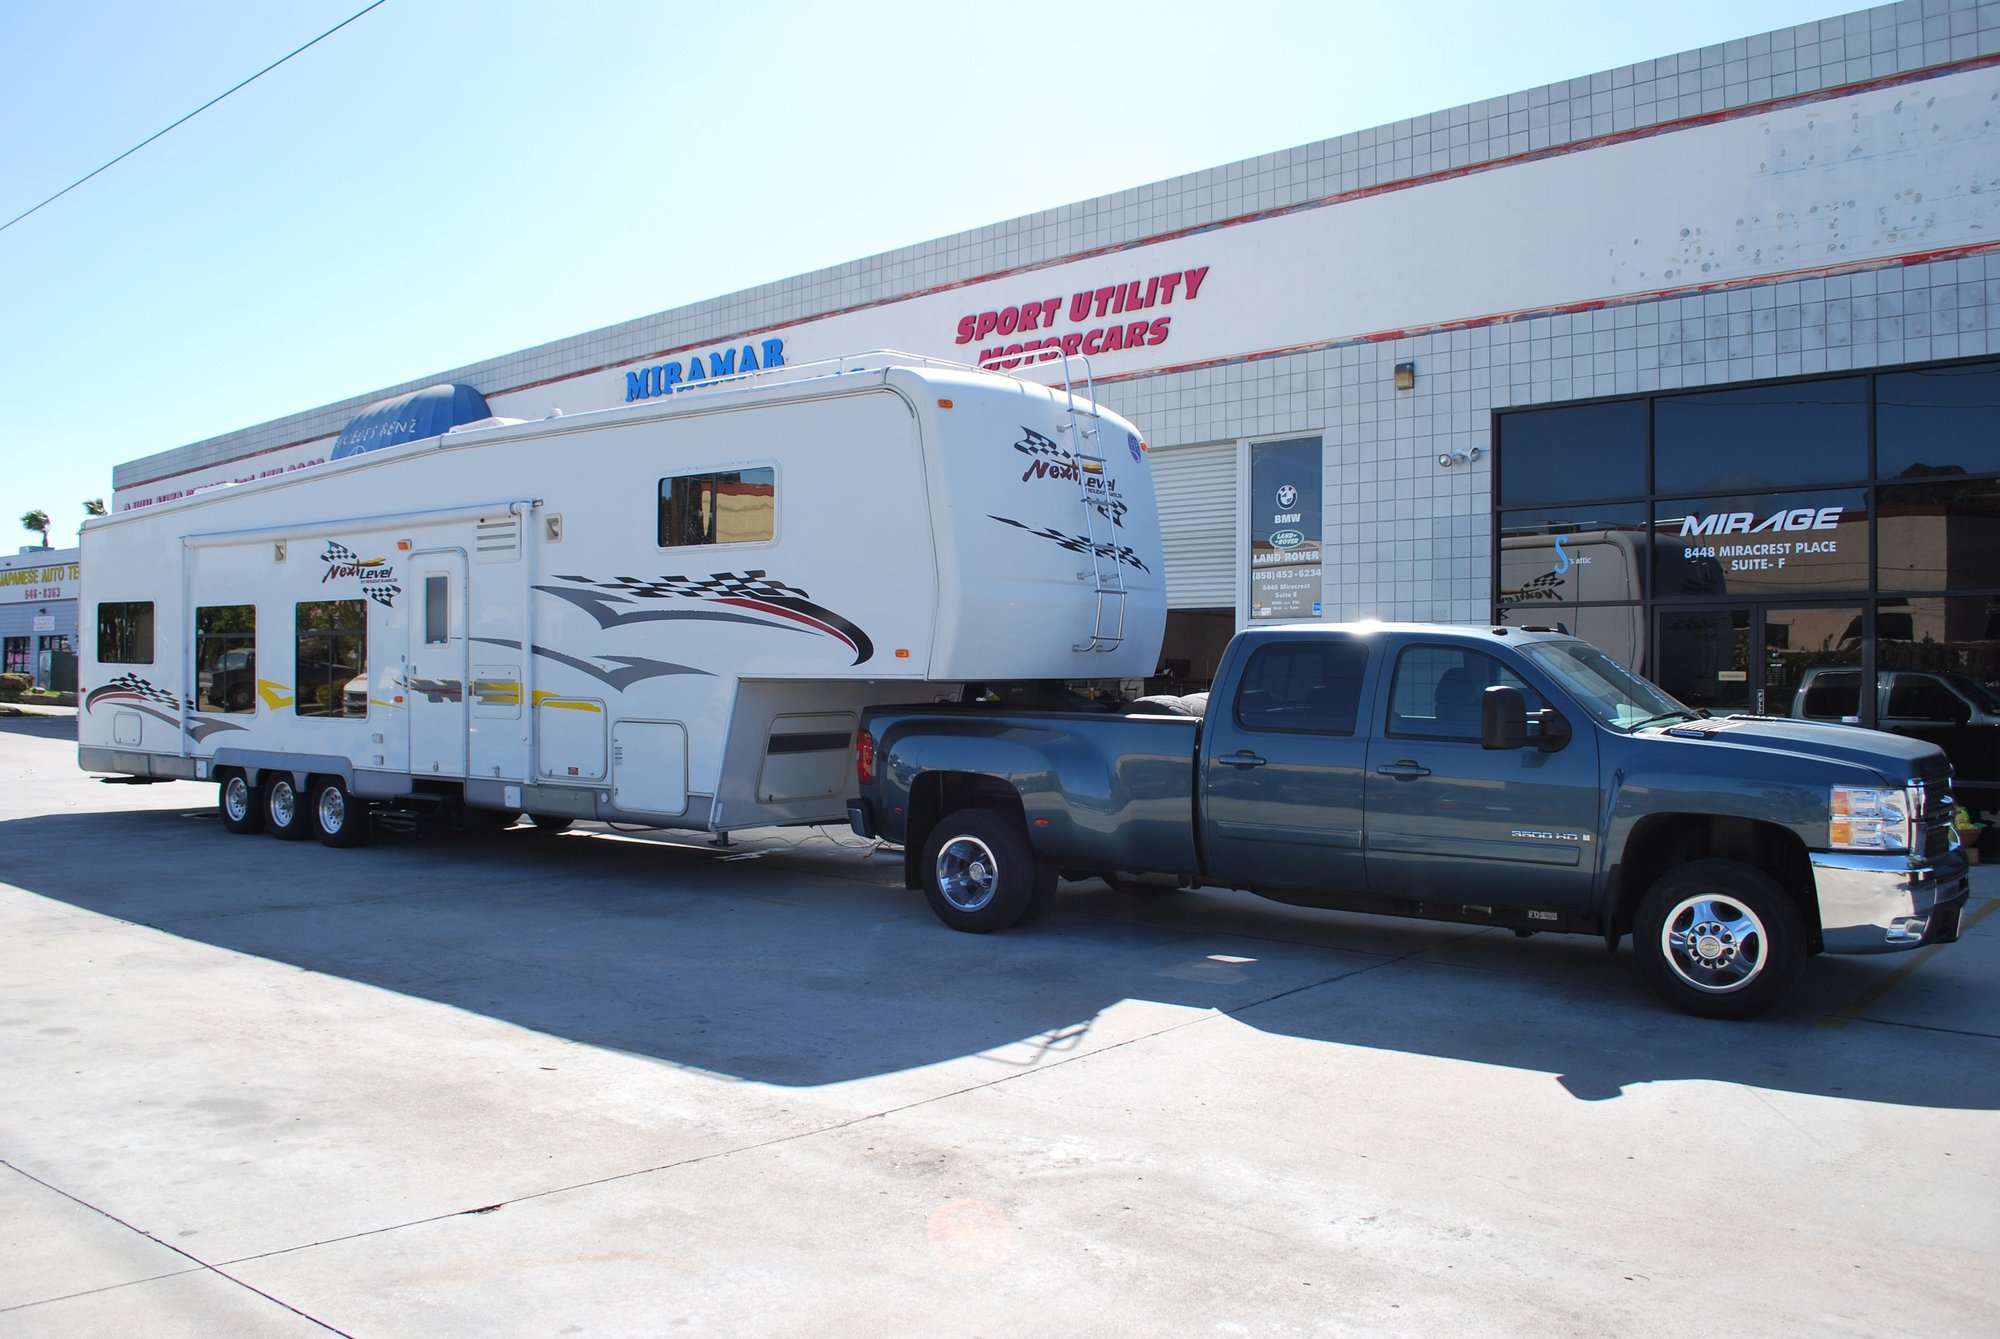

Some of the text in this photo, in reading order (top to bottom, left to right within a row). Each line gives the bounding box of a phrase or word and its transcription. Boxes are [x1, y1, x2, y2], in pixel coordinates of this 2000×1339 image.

[955, 265, 1210, 345] SPORT UTILITY
[977, 316, 1172, 371] MOTORCARS
[625, 338, 785, 402] MIRAMAR
[1021, 458, 1080, 483] Next
[1274, 513, 1302, 524] BMW
[1679, 506, 1844, 537] MIRAGE
[1253, 550, 1320, 563] LAND ROVER
[1684, 541, 1837, 559] 8448 MIRACREST PLACE
[1575, 556, 1592, 564] attic
[1778, 558, 1786, 569] F
[0, 568, 39, 586] JAPANESE
[41, 566, 65, 583] AUTO
[322, 558, 360, 584] Next
[359, 566, 393, 580] Level
[1511, 830, 1553, 839] 3500
